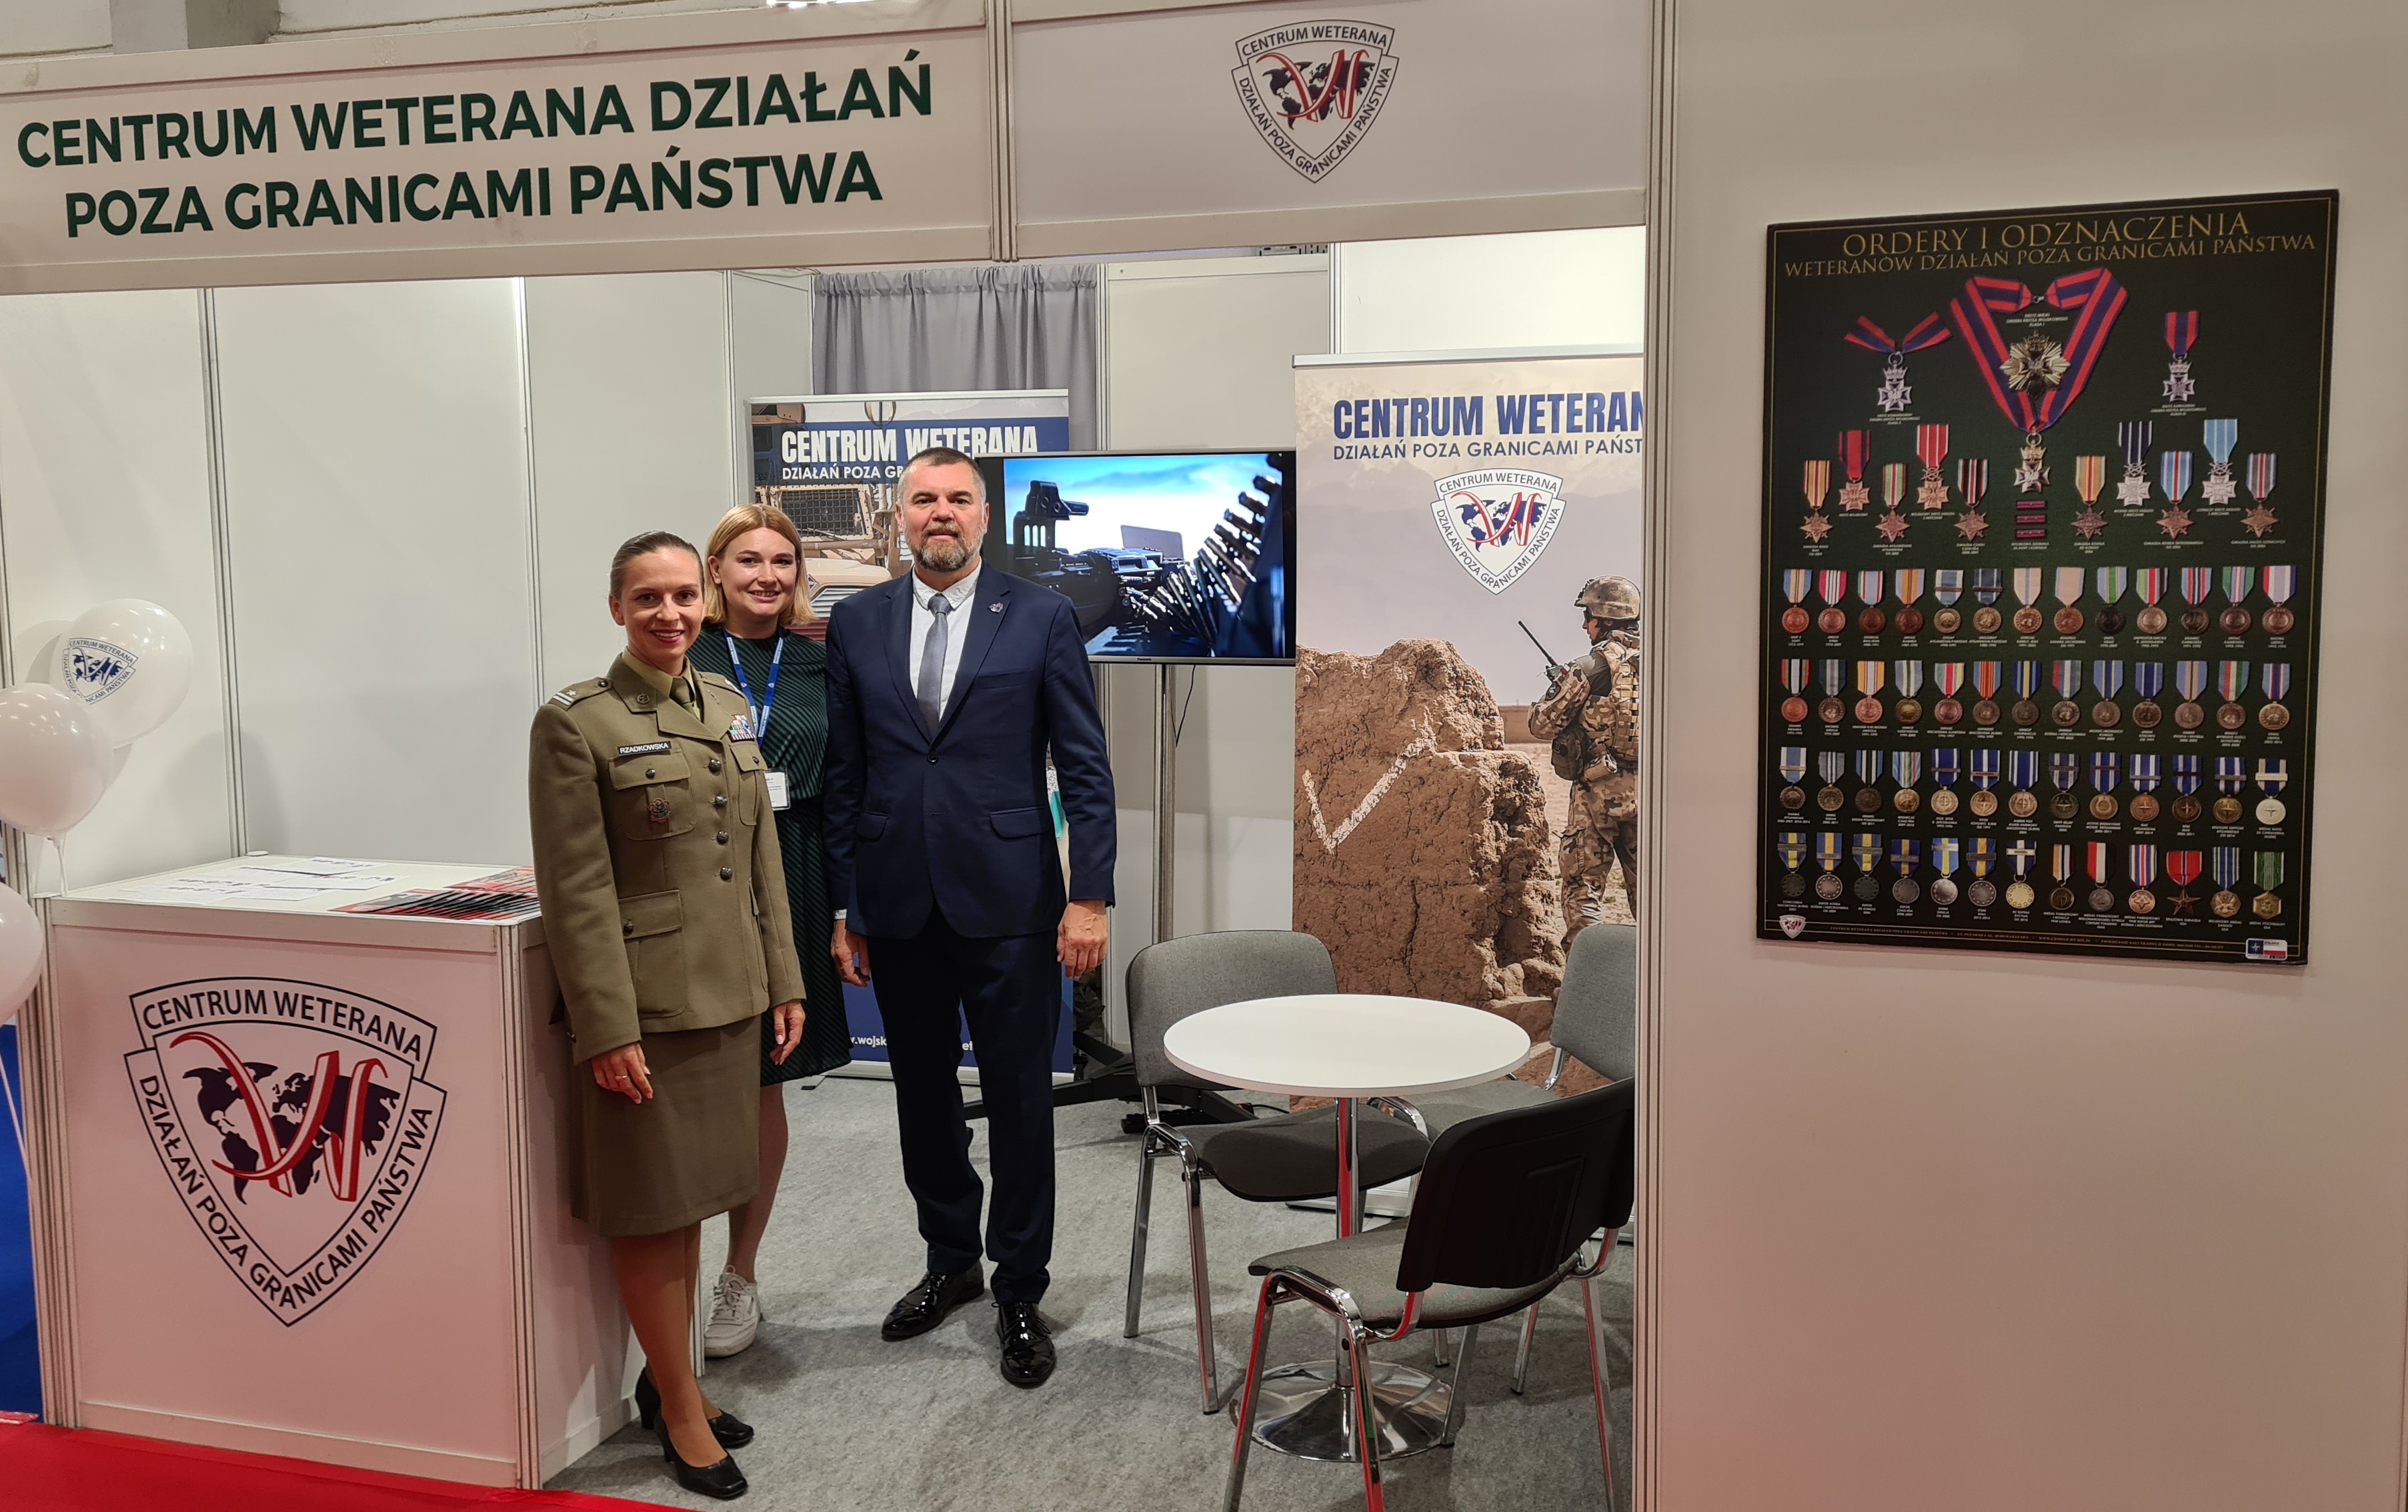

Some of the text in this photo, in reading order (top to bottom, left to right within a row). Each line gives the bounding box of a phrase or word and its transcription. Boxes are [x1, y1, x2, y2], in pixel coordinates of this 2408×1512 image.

[1242, 25, 1388, 56] CENTRUM WETERANA
[17, 48, 932, 168] CENTRUM WETERANA DZIAŁAŃ
[1239, 67, 1392, 175] DZIAŁAŃ POZA GRANICAMI PAŃSTWA
[65, 145, 884, 238] POZA GRANICAMI PAŃSTWA
[1784, 233, 2316, 277] WETERANÓW DZIAŁAŃ POZA GRANICAMI PAŃSTWA
[1843, 210, 2251, 257] ORDERY I ODZNACZENIA
[1334, 395, 1484, 439] CENTRUM
[782, 429, 897, 463] CENTRUM
[1334, 439, 1406, 460] DZIAŁAŃ
[1412, 443, 1461, 458] POZA
[1467, 439, 1578, 457] GRANICAMI
[782, 463, 840, 480] DZIAŁAŃ
[844, 466, 881, 479] POZA
[1439, 472, 1558, 493] CENTRUM WETERANA
[1436, 507, 1560, 589] DZIAŁAŃ POZA GRANICAMI PAŃSTWA
[98, 643, 133, 664] WETERANA
[620, 742, 670, 754] RZADKOWSKA
[142, 989, 421, 1062] CENTRUM WETERANA
[139, 1074, 433, 1309] DZIAŁAŃ POZA GRANICAMI PAŃSTWA
